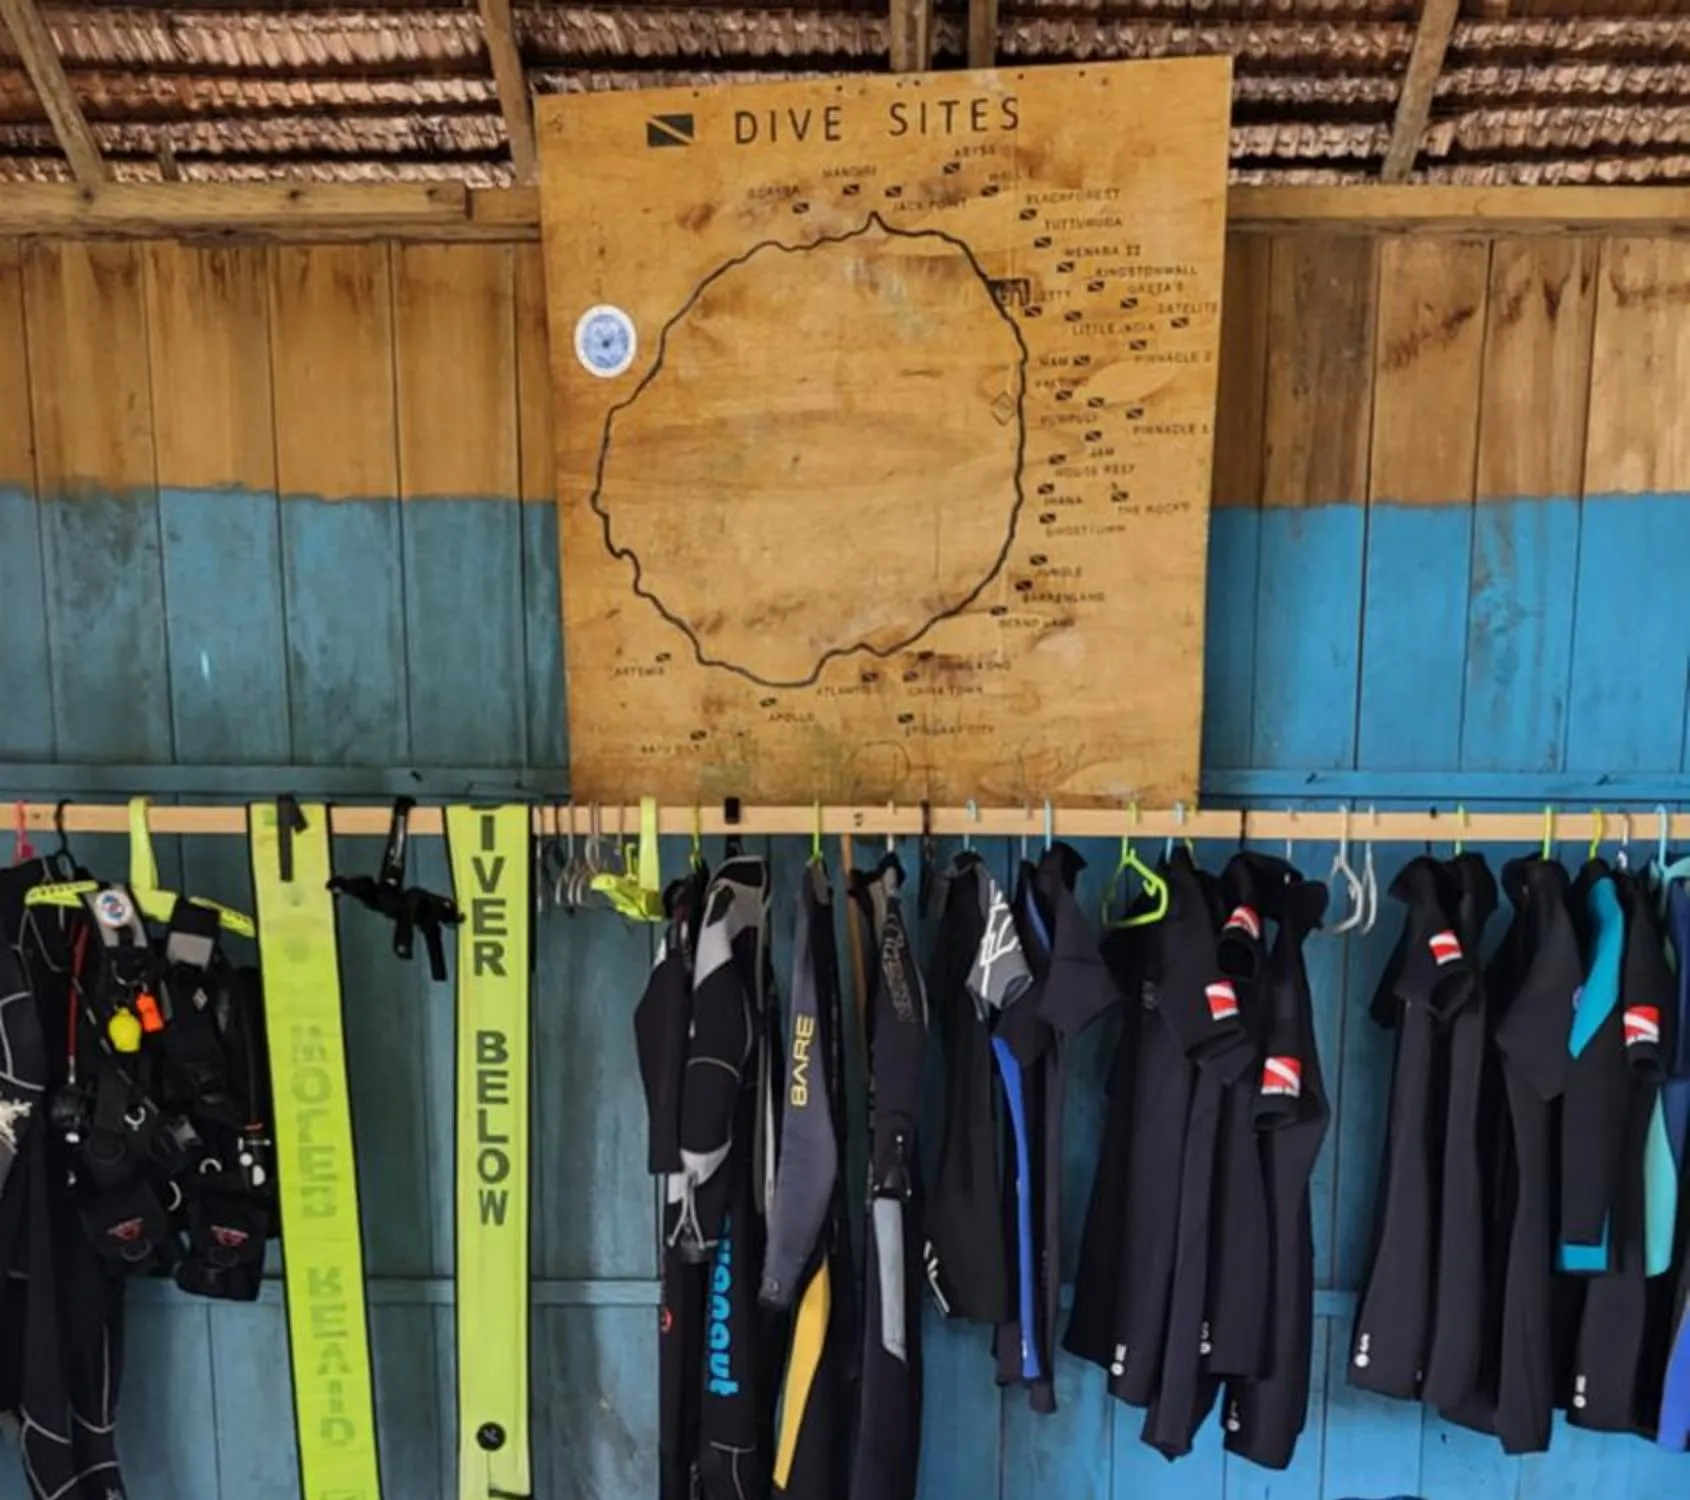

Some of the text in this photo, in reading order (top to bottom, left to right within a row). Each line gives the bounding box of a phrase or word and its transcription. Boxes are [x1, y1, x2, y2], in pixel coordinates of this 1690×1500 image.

[735, 97, 1020, 145] DIVE SITES
[467, 803, 511, 1228] IVER BELOW
[790, 1012, 816, 1108] BARE
